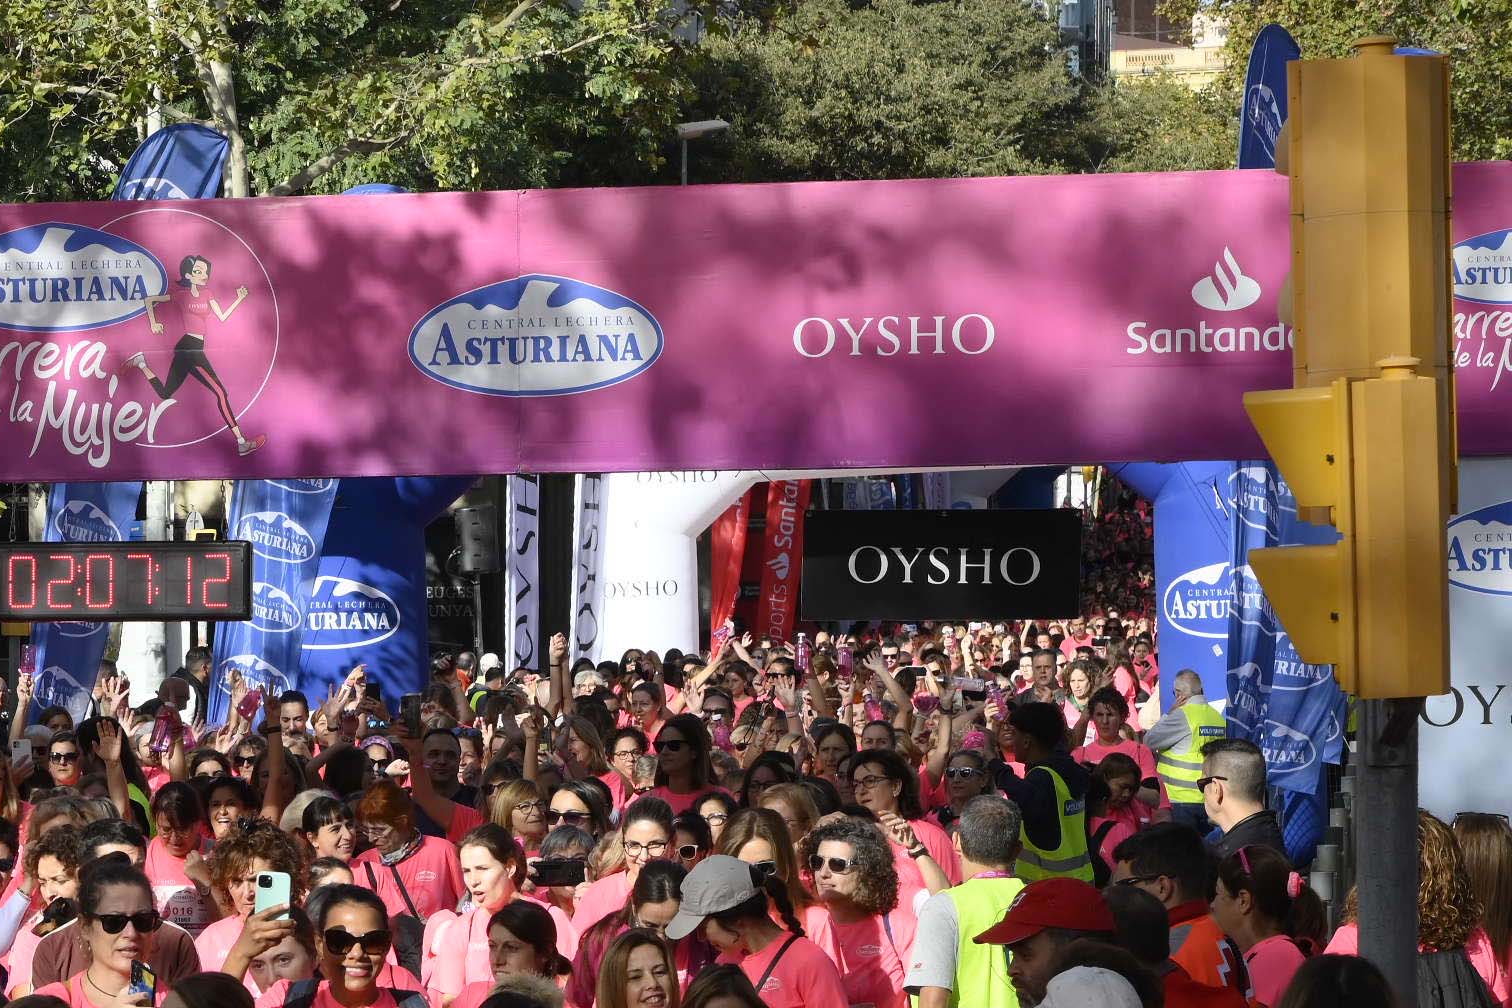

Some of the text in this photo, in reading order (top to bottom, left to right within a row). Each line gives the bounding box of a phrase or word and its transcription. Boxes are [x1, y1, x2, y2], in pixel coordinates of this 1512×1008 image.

[71, 258, 144, 271] LECHERA
[467, 314, 635, 330] CENTRAL LECHERA
[793, 314, 996, 358] OYSHO
[428, 321, 643, 366] ASTURIANA
[1476, 340, 1495, 368] la
[8, 383, 34, 424] la
[28, 375, 177, 469] Mujer
[239, 521, 309, 557] ASTURIANA
[9, 554, 231, 609] 02:07:12
[848, 546, 1041, 585] OYSHO
[307, 611, 391, 631] URIANA
[1419, 685, 1512, 727] OY
[172, 907, 193, 916] 016
